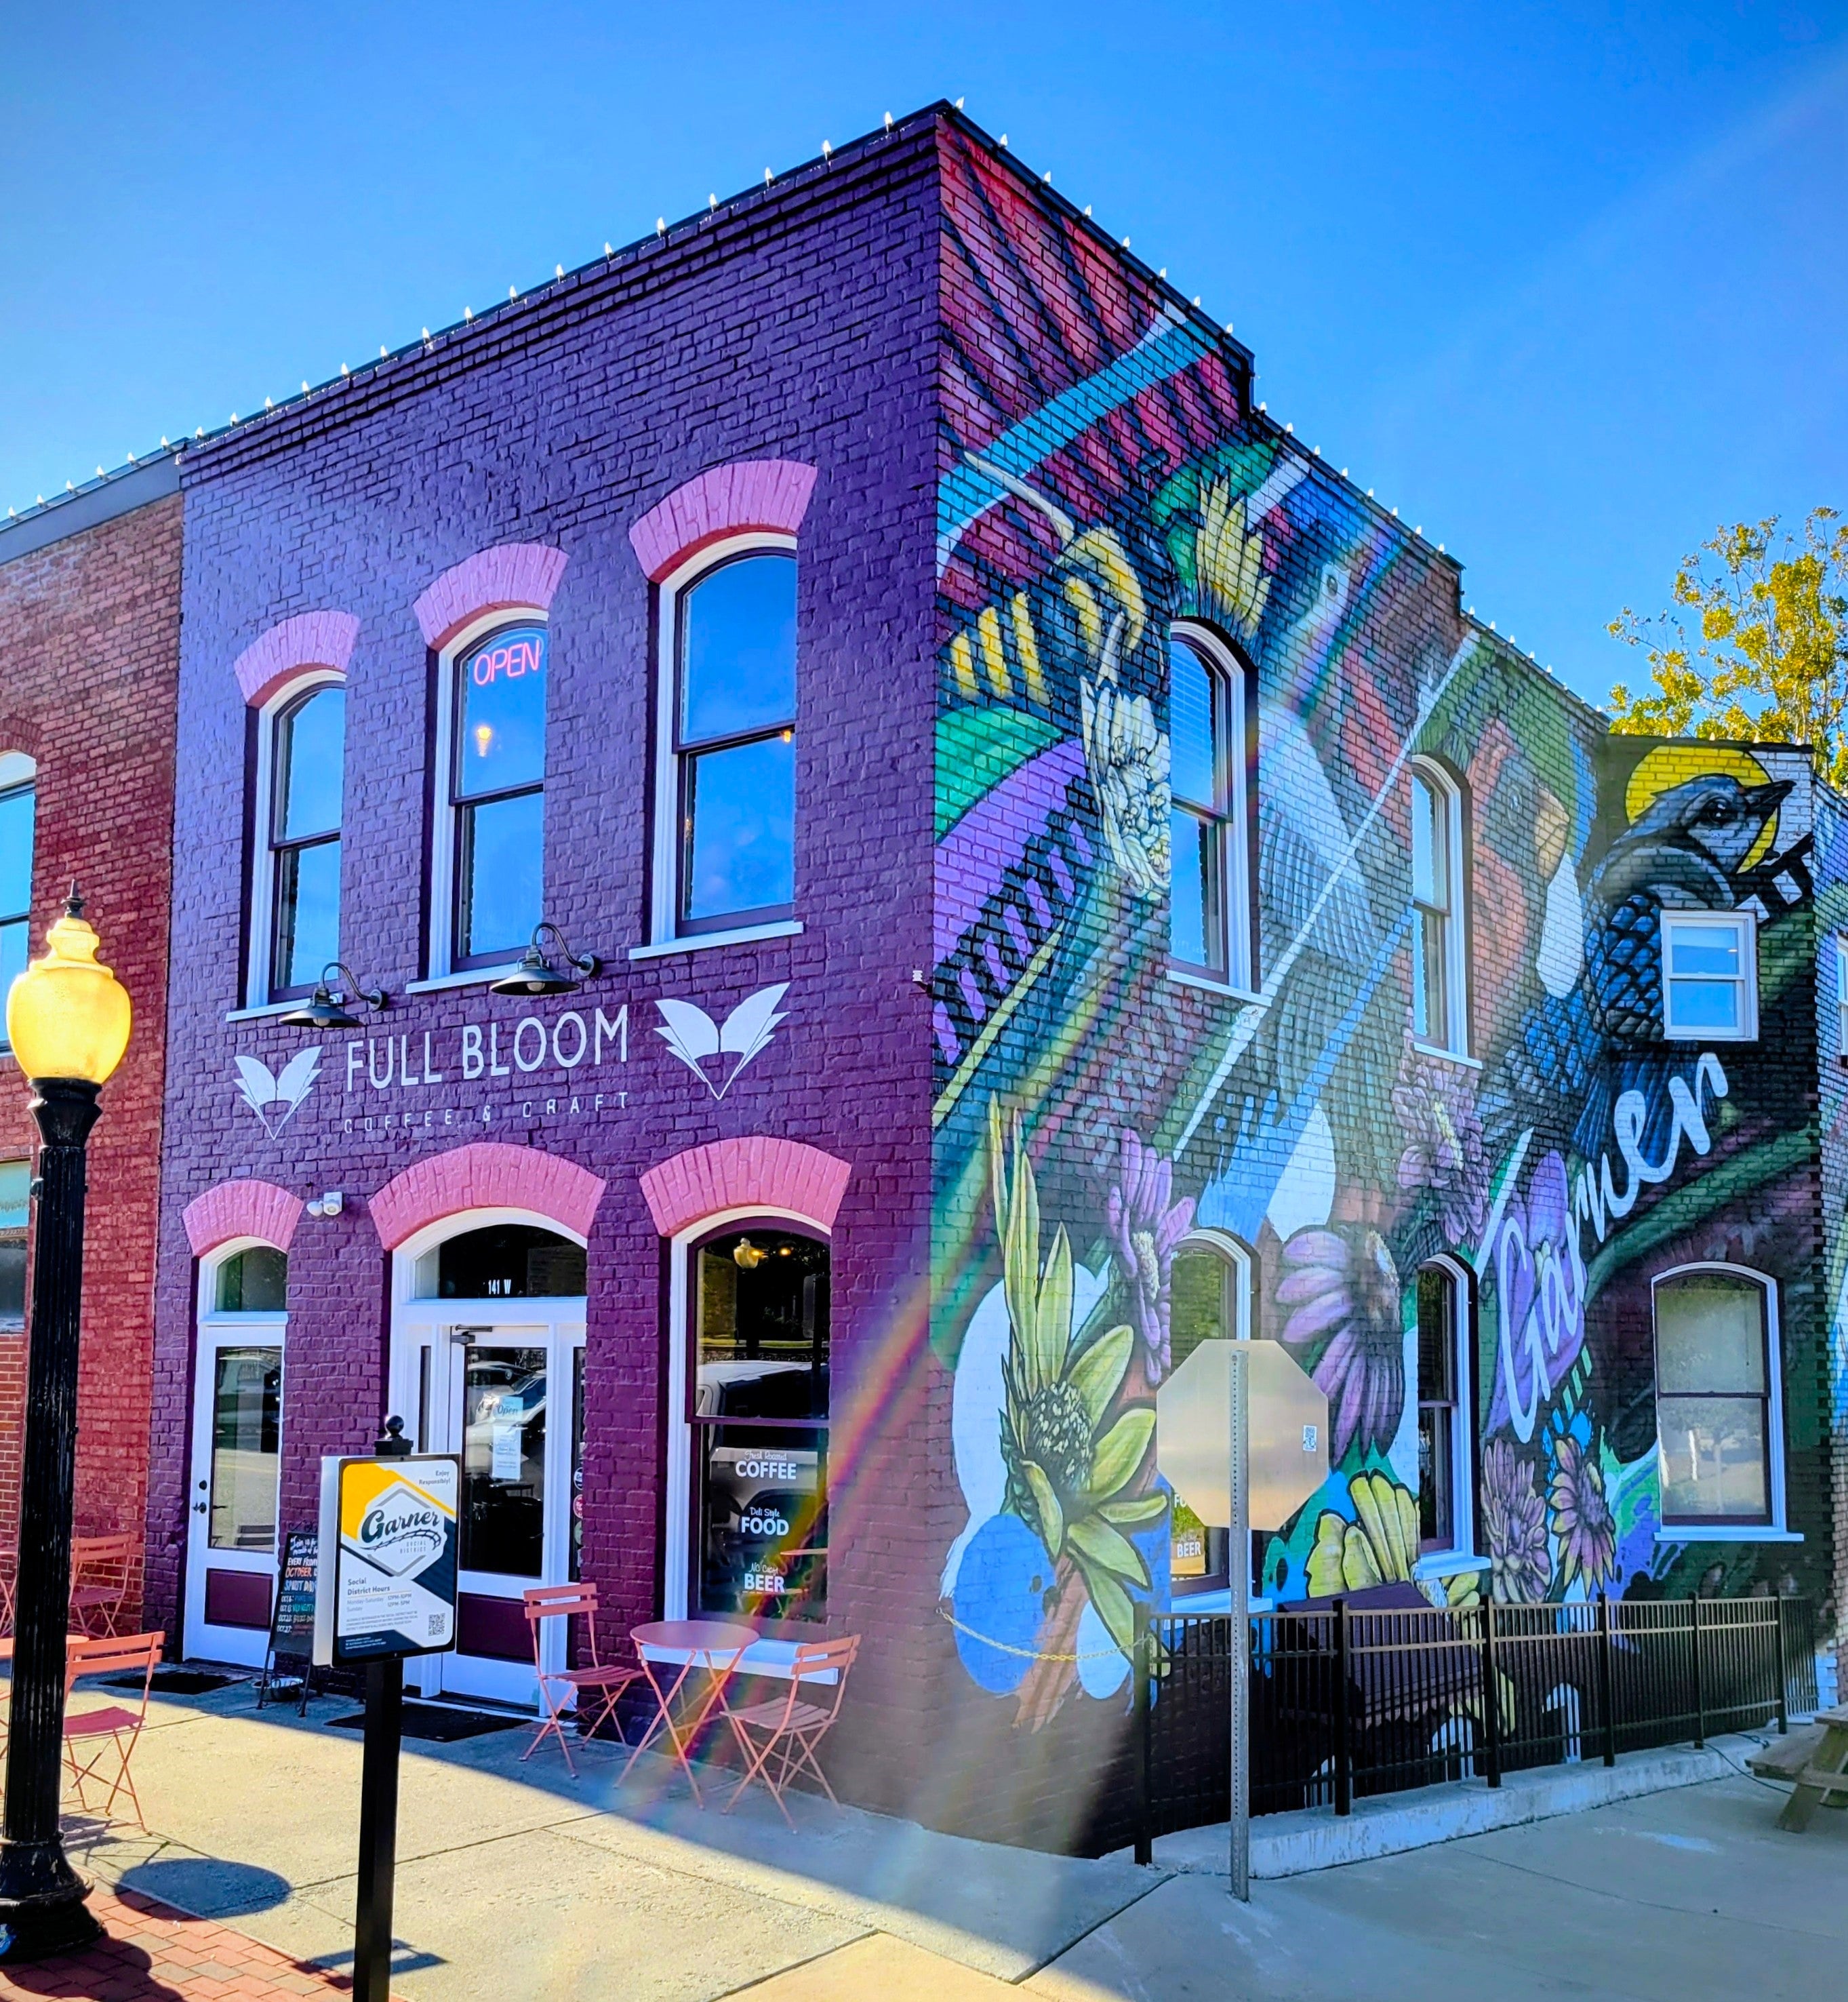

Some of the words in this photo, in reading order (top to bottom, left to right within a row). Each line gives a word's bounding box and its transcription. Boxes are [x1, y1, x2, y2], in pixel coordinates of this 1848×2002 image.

[474, 639, 540, 686] OPEN
[346, 1030, 442, 1092] FULL
[462, 1004, 628, 1080] BLOOM
[344, 1108, 453, 1134] COFFEE
[482, 1105, 495, 1122] &
[522, 1092, 628, 1119] CRAFT
[1500, 1052, 1728, 1443] Garner
[488, 1279, 500, 1295] 141
[744, 1450, 763, 1461] Fresh
[765, 1450, 787, 1460] Roasted
[736, 1460, 797, 1480] COFFEE
[750, 1506, 763, 1516] Deli
[764, 1508, 780, 1519] Style
[361, 1509, 440, 1543] Garner
[741, 1517, 789, 1536] FOOD
[1177, 1541, 1201, 1558] BEER
[287, 1557, 302, 1566] EVERY
[285, 1567, 312, 1578] OCTOBER
[347, 1587, 371, 1595] District
[348, 1578, 367, 1586] Social
[744, 1573, 785, 1593] BEER
